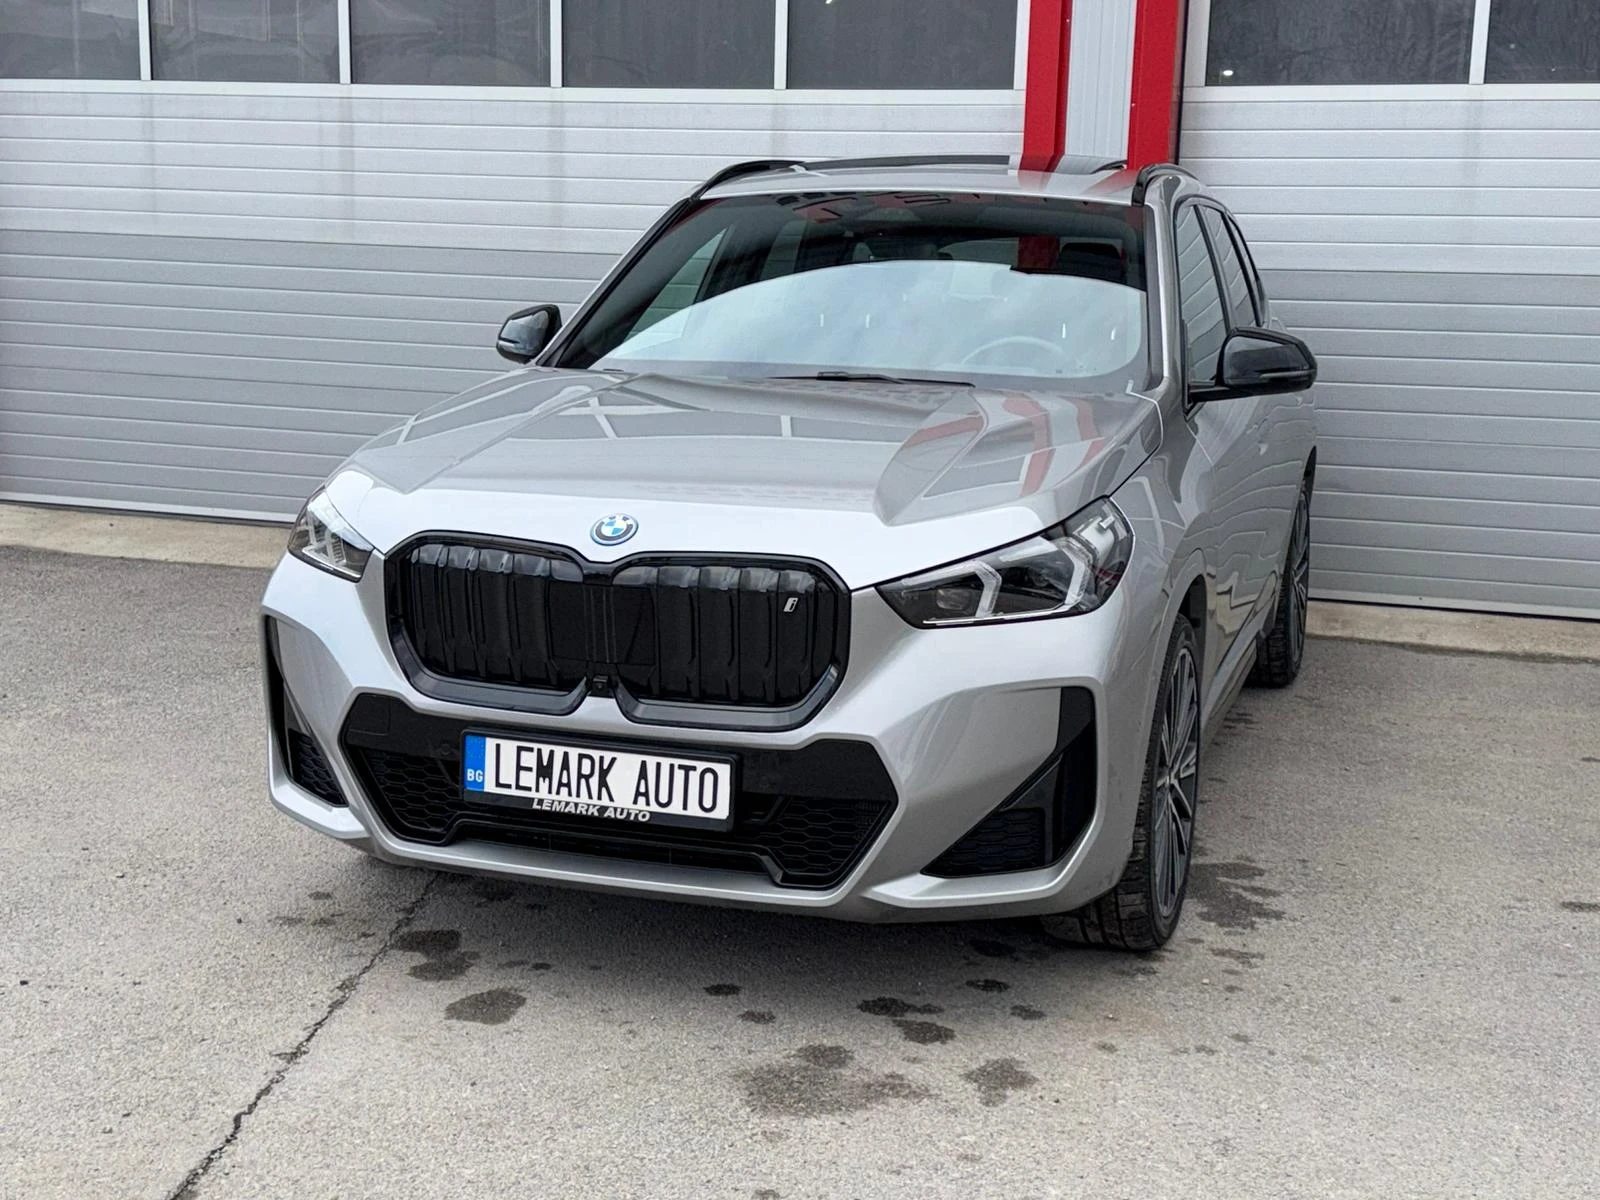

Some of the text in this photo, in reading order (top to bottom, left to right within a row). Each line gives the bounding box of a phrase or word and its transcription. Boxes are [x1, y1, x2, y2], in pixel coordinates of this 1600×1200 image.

[466, 769, 484, 783] BG
[494, 743, 719, 813] LEMARK AUTO
[532, 798, 650, 822] LEMARK AUTO
